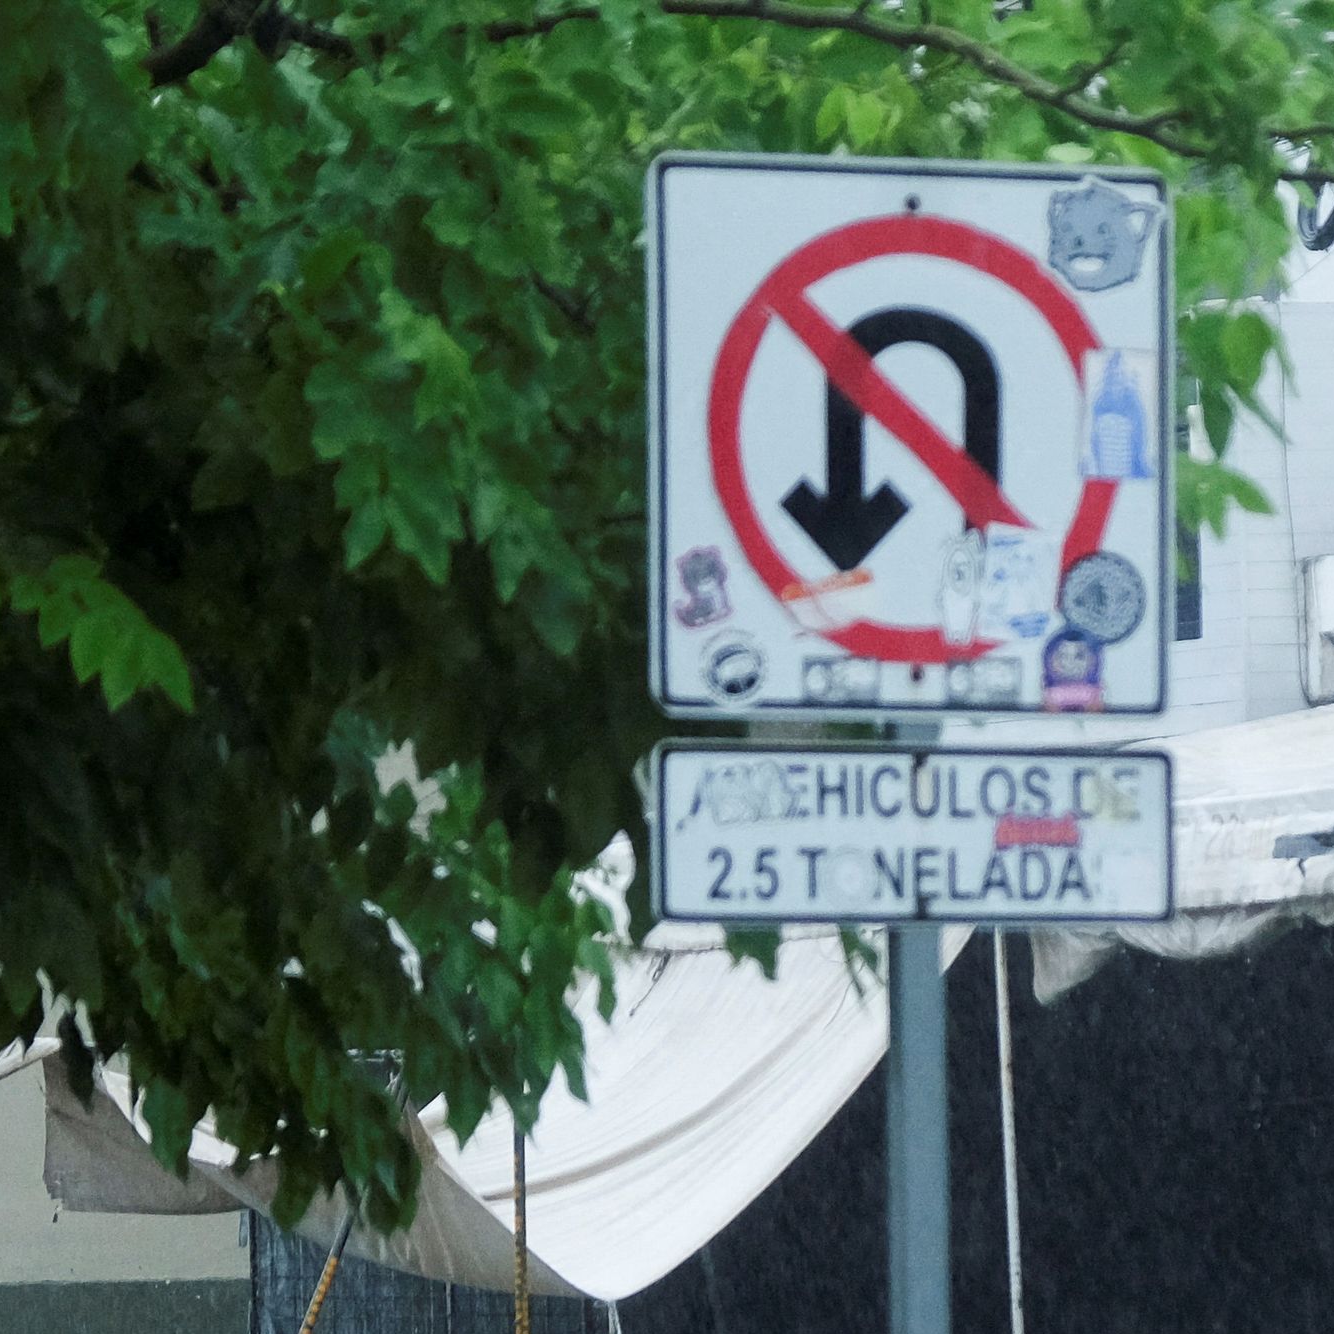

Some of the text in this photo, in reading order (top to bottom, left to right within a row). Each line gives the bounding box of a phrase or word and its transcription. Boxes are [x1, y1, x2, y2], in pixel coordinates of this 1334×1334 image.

[745, 764, 1053, 819] EHICULOS
[708, 847, 1103, 901] 2.5 TNELADA
